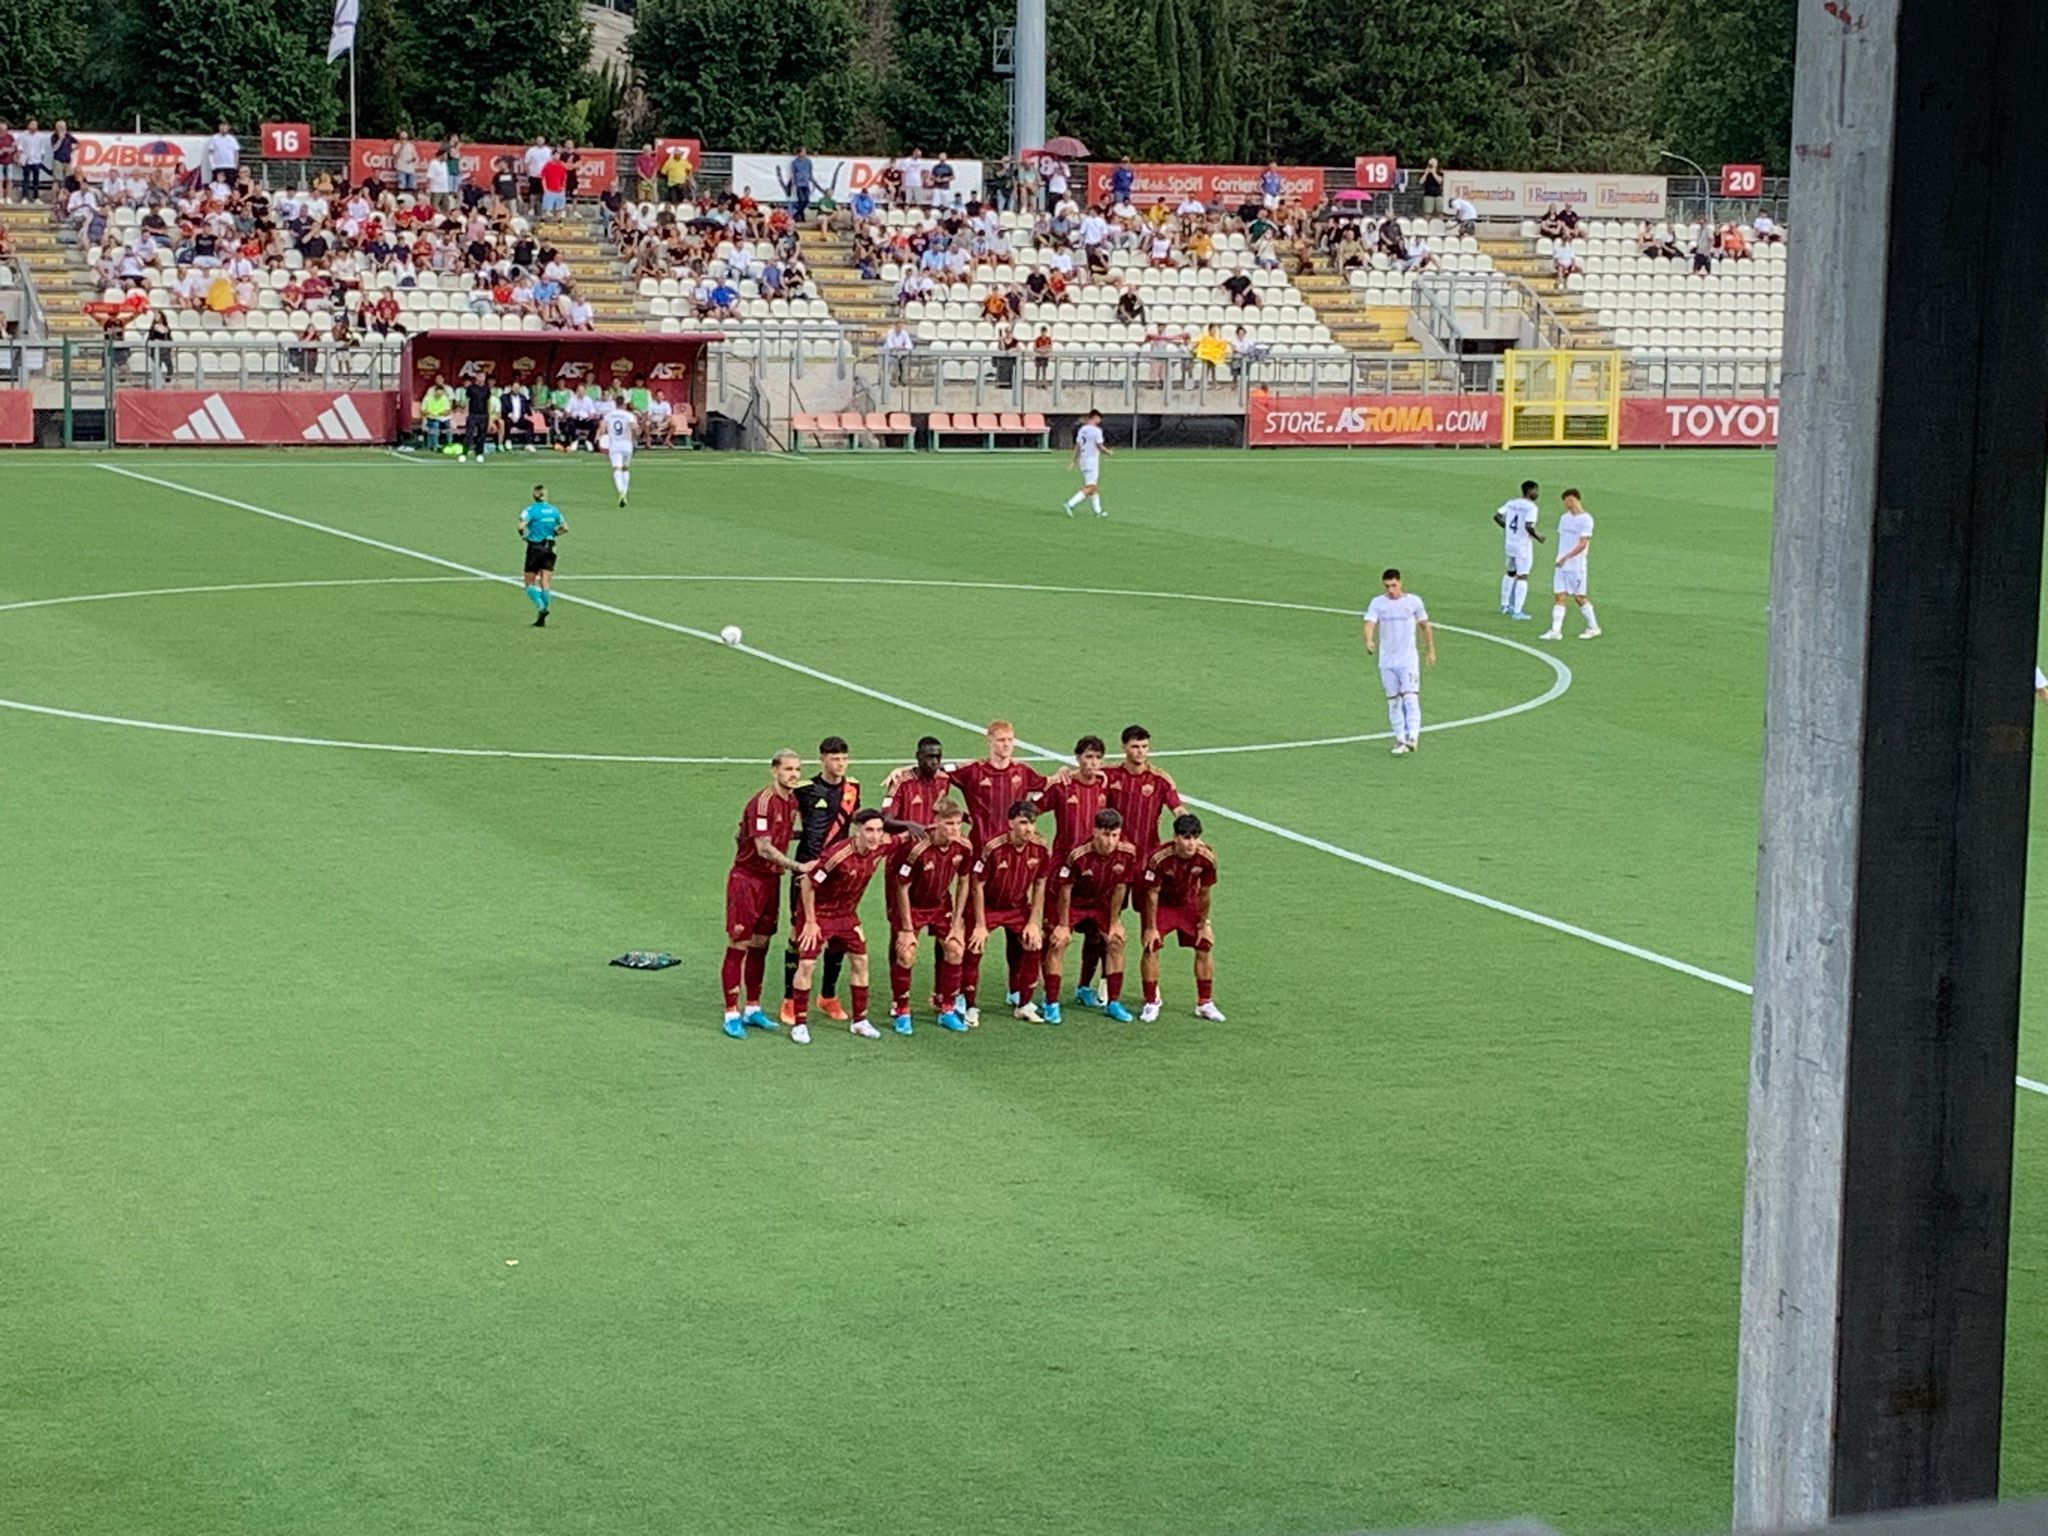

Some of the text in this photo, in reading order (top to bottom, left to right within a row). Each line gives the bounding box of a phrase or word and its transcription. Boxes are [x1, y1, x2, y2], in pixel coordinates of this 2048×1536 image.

[272, 130, 299, 152] 16
[1365, 163, 1388, 183] 19
[1729, 171, 1756, 191] 20
[649, 362, 686, 379] ASR
[613, 420, 623, 436] 9
[1264, 407, 1488, 433] STORE.ASROMA.COM
[1666, 405, 1779, 437] TOYOT
[1509, 514, 1519, 534] 4
